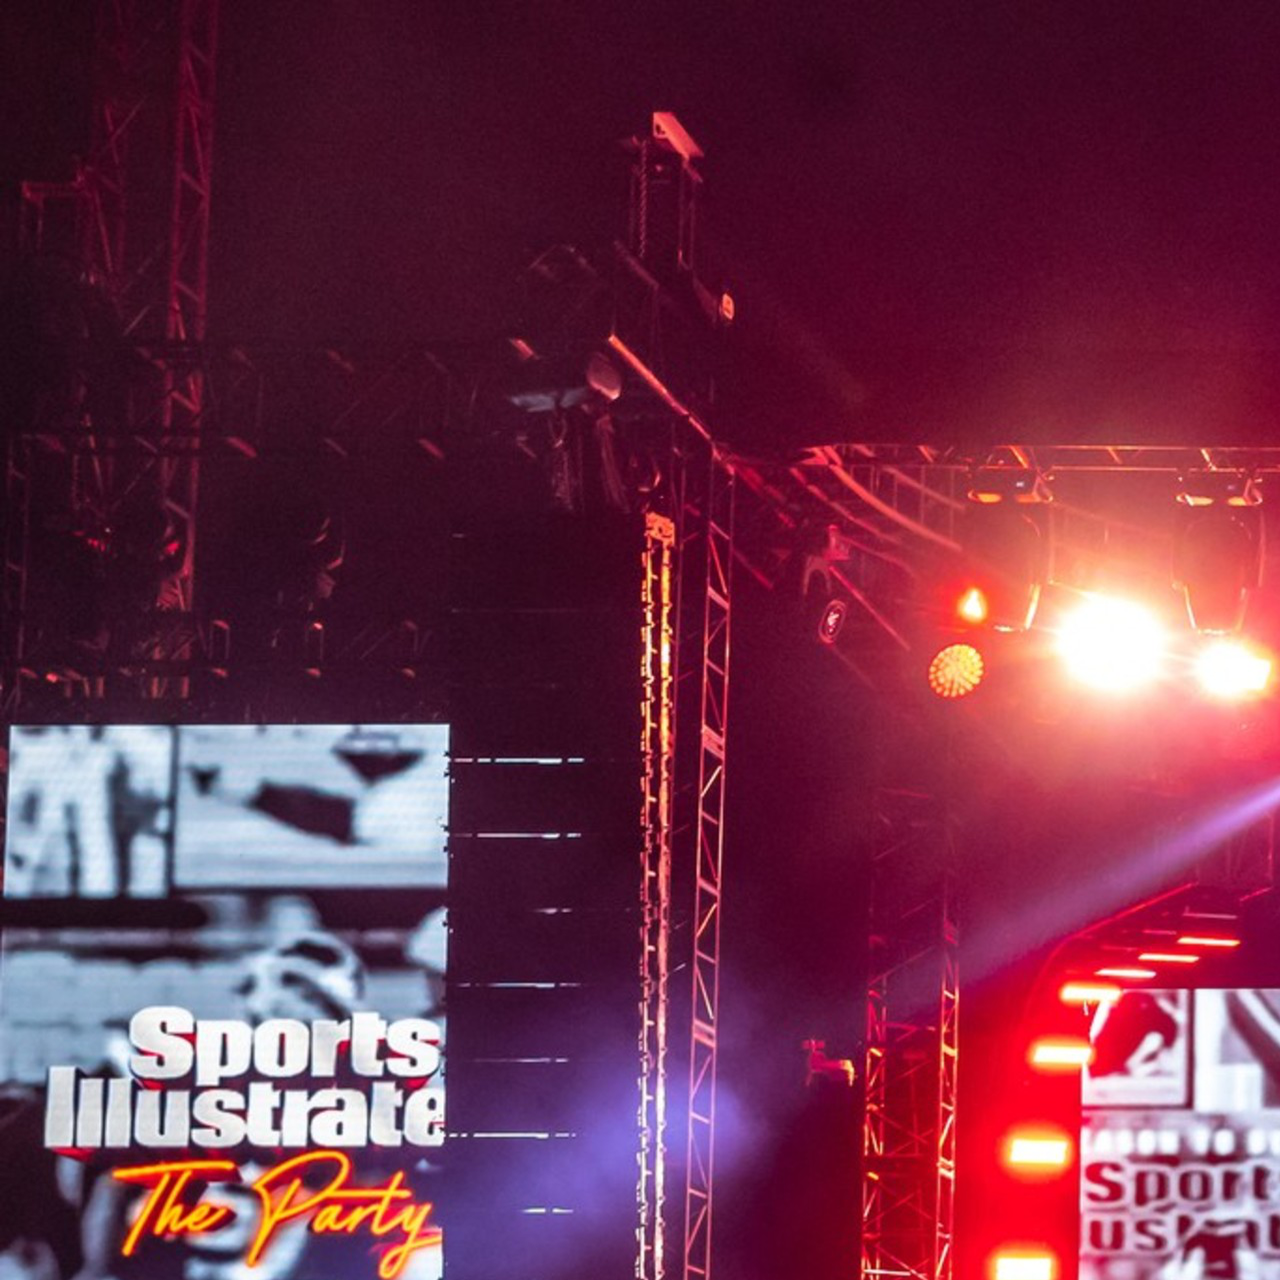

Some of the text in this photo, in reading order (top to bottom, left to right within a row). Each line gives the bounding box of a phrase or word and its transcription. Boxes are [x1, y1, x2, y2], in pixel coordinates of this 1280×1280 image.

[128, 1005, 442, 1085] Sports
[44, 1065, 445, 1148] Illustrate
[112, 1151, 443, 1280] The Party
